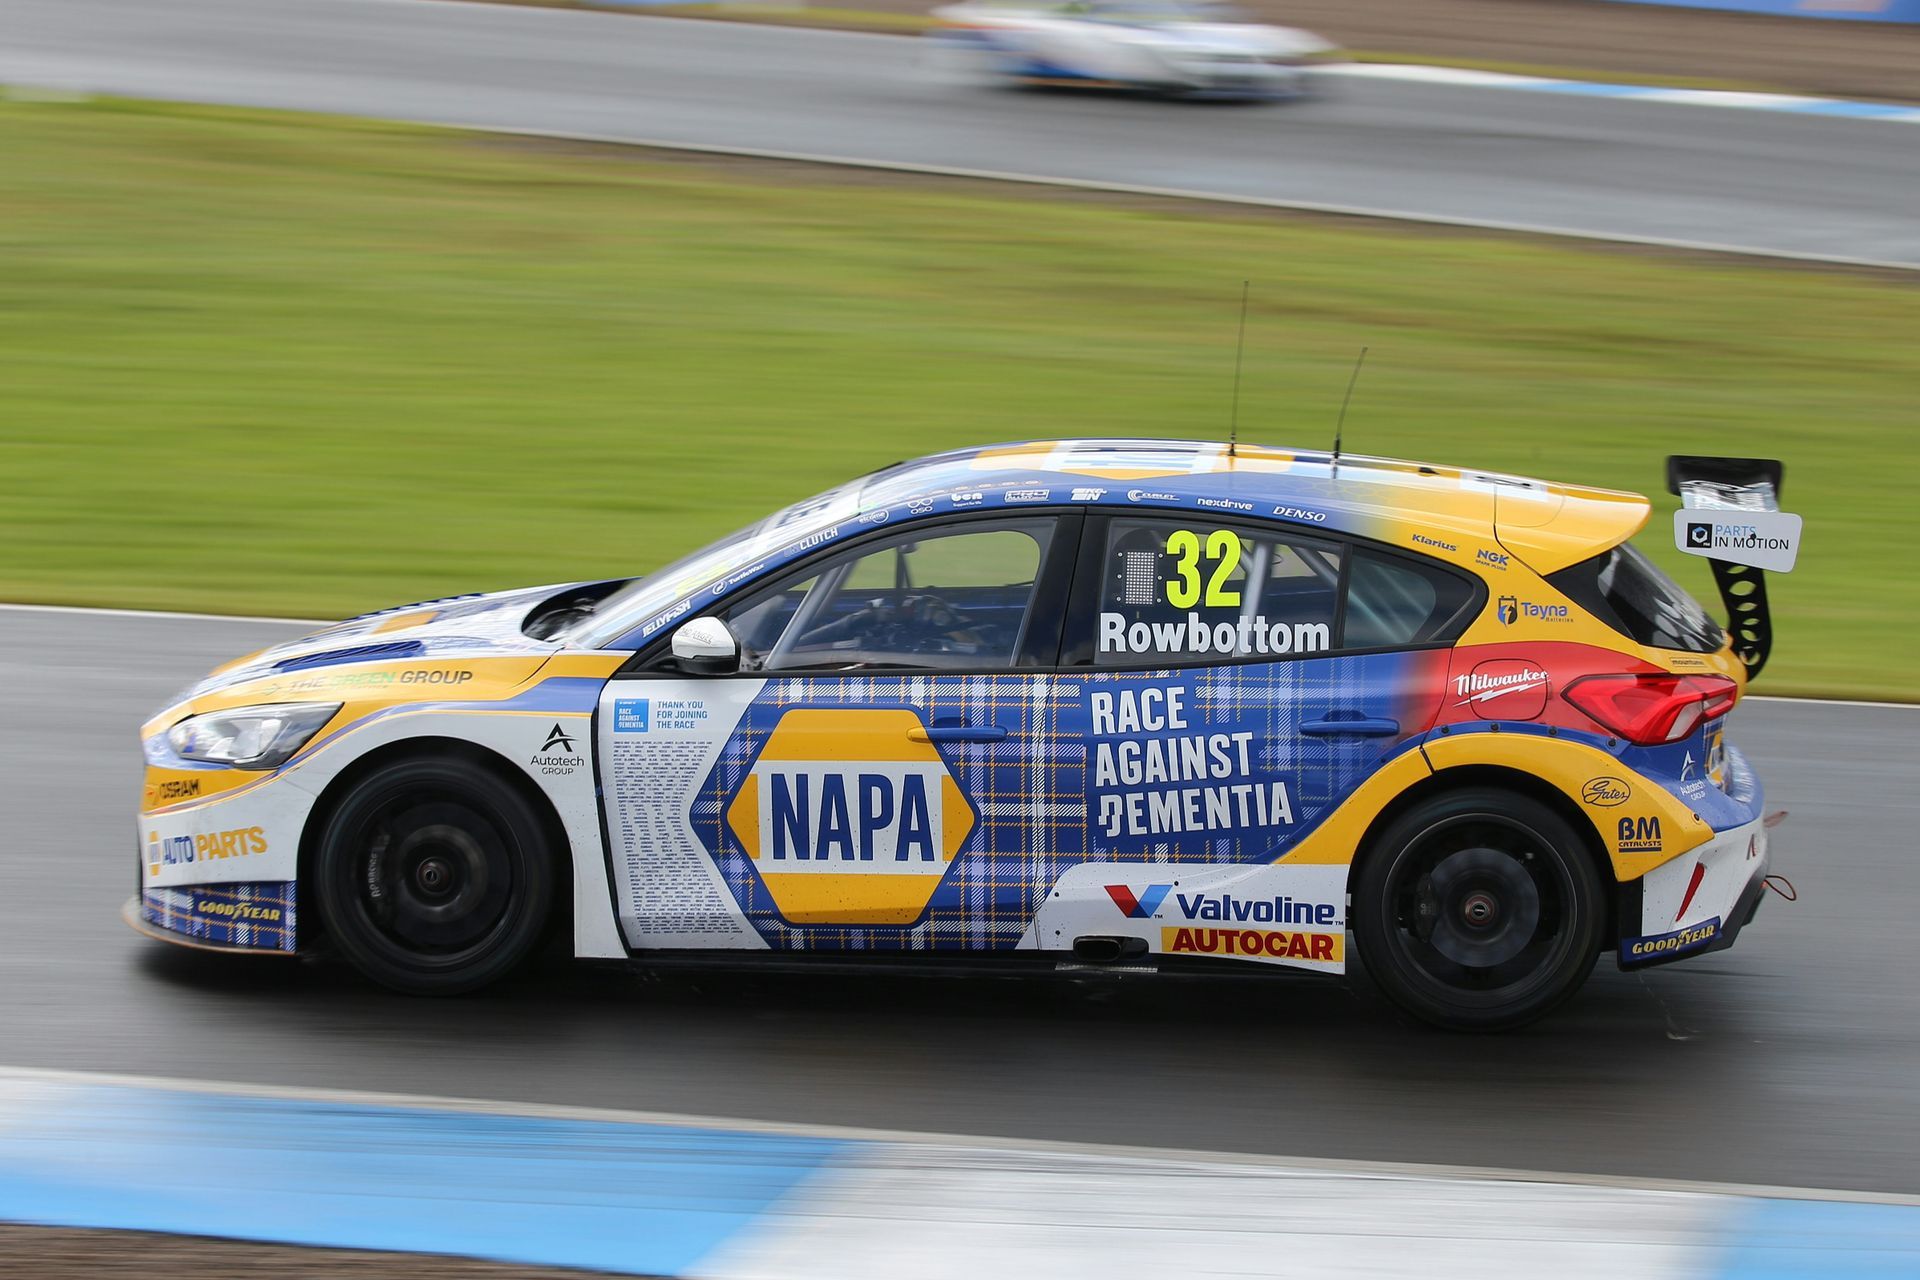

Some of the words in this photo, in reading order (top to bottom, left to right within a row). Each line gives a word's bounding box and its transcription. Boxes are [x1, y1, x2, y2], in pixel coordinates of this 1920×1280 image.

[1197, 498, 1253, 510] nexdrive
[1272, 505, 1327, 522] DENSO
[800, 527, 839, 550] CLUTCH
[1715, 525, 1757, 536] PARTS
[1412, 534, 1457, 552] Klarius
[1715, 537, 1728, 547] IN
[1733, 537, 1789, 550] MOTION
[1477, 549, 1509, 566] NGK
[1166, 529, 1241, 609] 32
[1521, 602, 1568, 620] Tayna
[1100, 611, 1330, 654] Rowbottom
[400, 670, 473, 685] GROUP
[1451, 668, 1549, 696] Milwaukee
[656, 711, 673, 719] FOR
[675, 711, 708, 719] JOINING
[658, 701, 685, 709] THANK
[687, 701, 704, 709] YOU
[1090, 686, 1188, 735] RACE
[656, 721, 672, 729] THE
[674, 721, 695, 729] RACE
[530, 755, 585, 767] Autotech
[1095, 732, 1253, 787] AGAINST
[541, 767, 574, 775] GROUP
[770, 773, 935, 861] NAPA
[1098, 782, 1294, 837] DEMENTIA
[1618, 816, 1661, 841] BM
[163, 835, 195, 865] AUTO
[196, 826, 268, 861] PARTS
[198, 900, 281, 921] GOODYEAR
[1176, 893, 1336, 925] Valvoline
[1172, 927, 1334, 961] AUTOCAR
[1632, 924, 1715, 954] GOODYEAR
